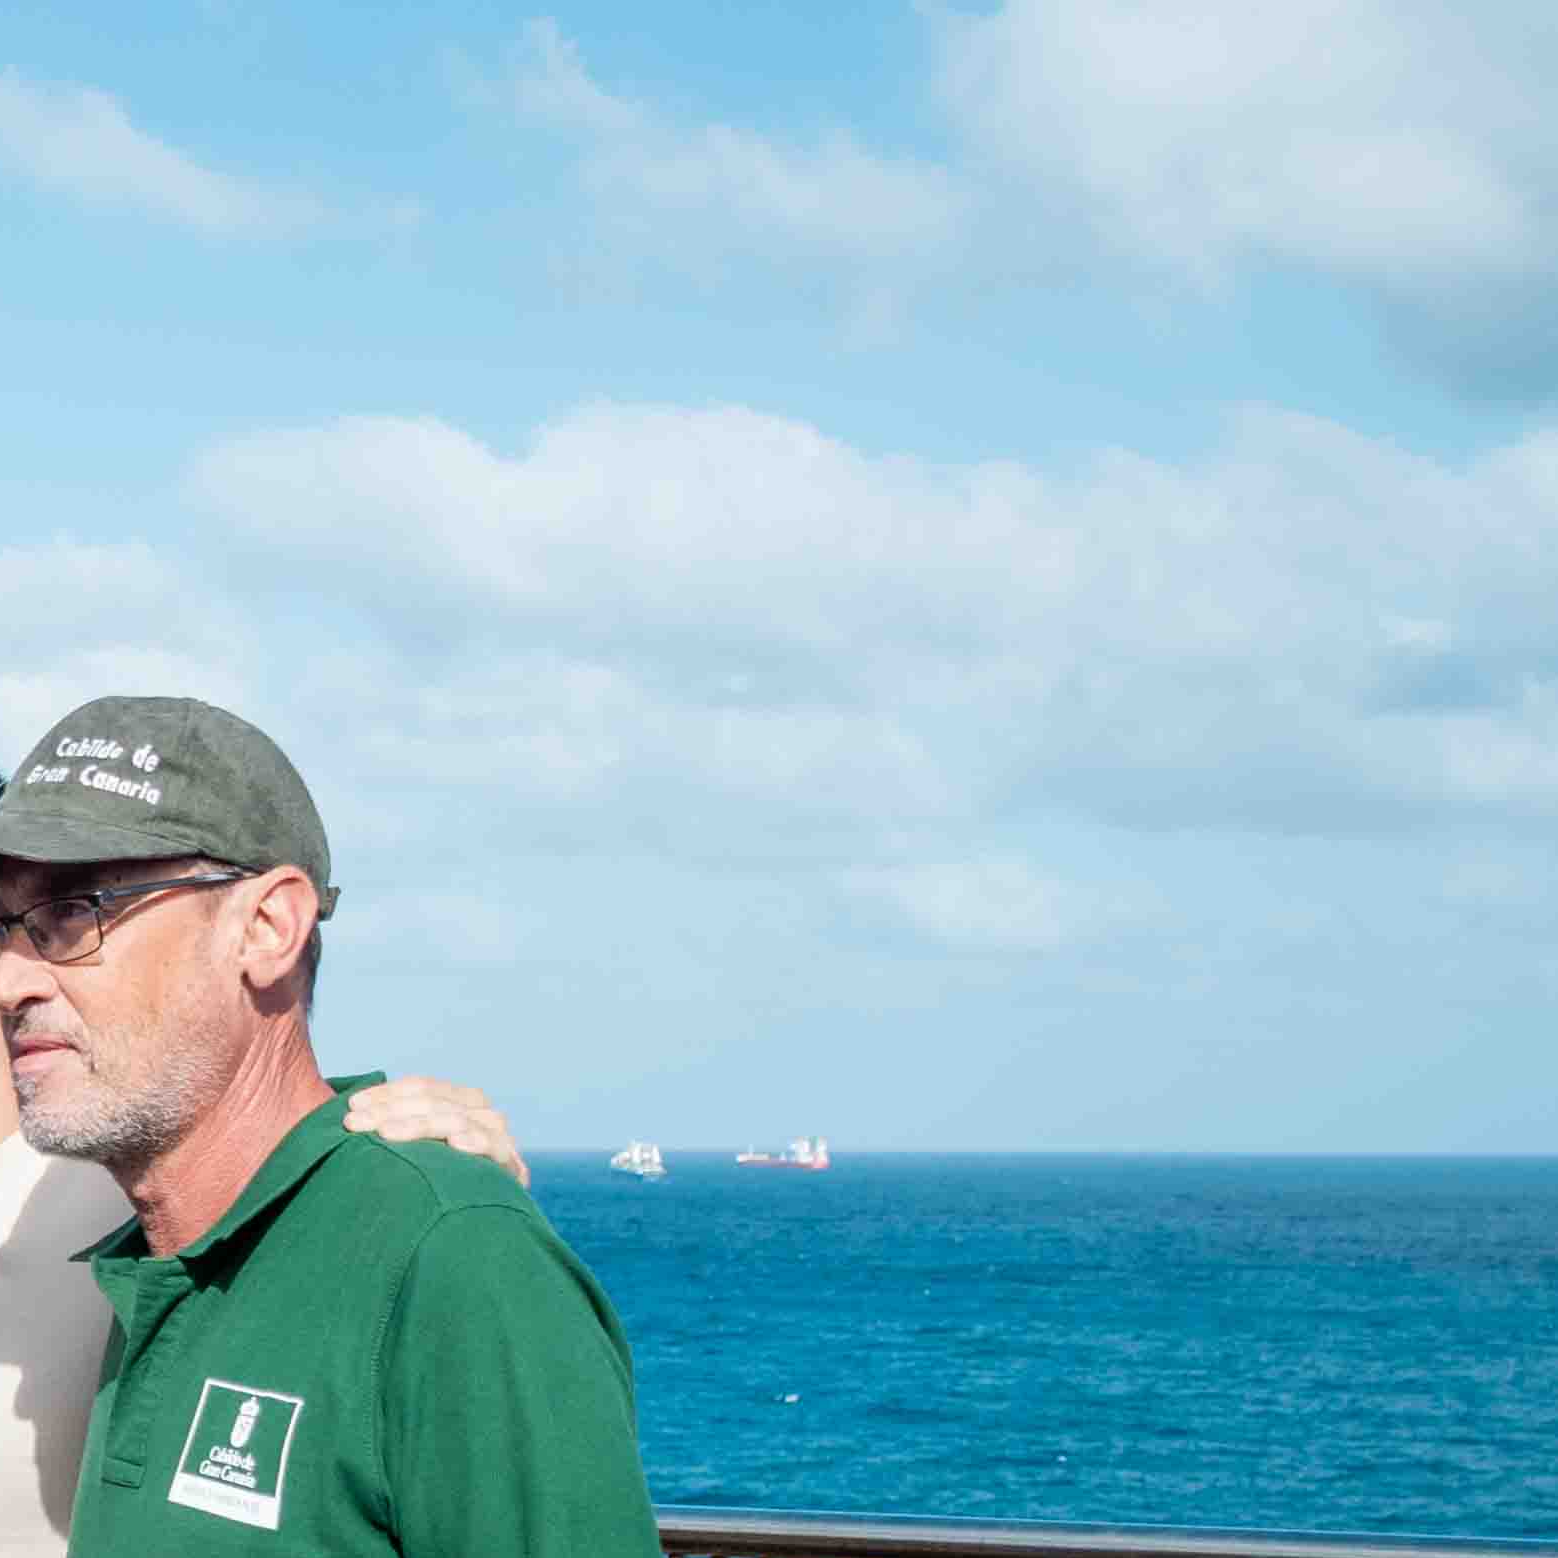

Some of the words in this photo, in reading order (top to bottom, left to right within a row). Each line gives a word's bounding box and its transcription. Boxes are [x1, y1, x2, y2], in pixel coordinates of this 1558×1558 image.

[56, 737, 124, 760] Cabildo
[132, 744, 160, 773] de
[26, 764, 70, 785] Gran
[79, 765, 161, 805] Canaria
